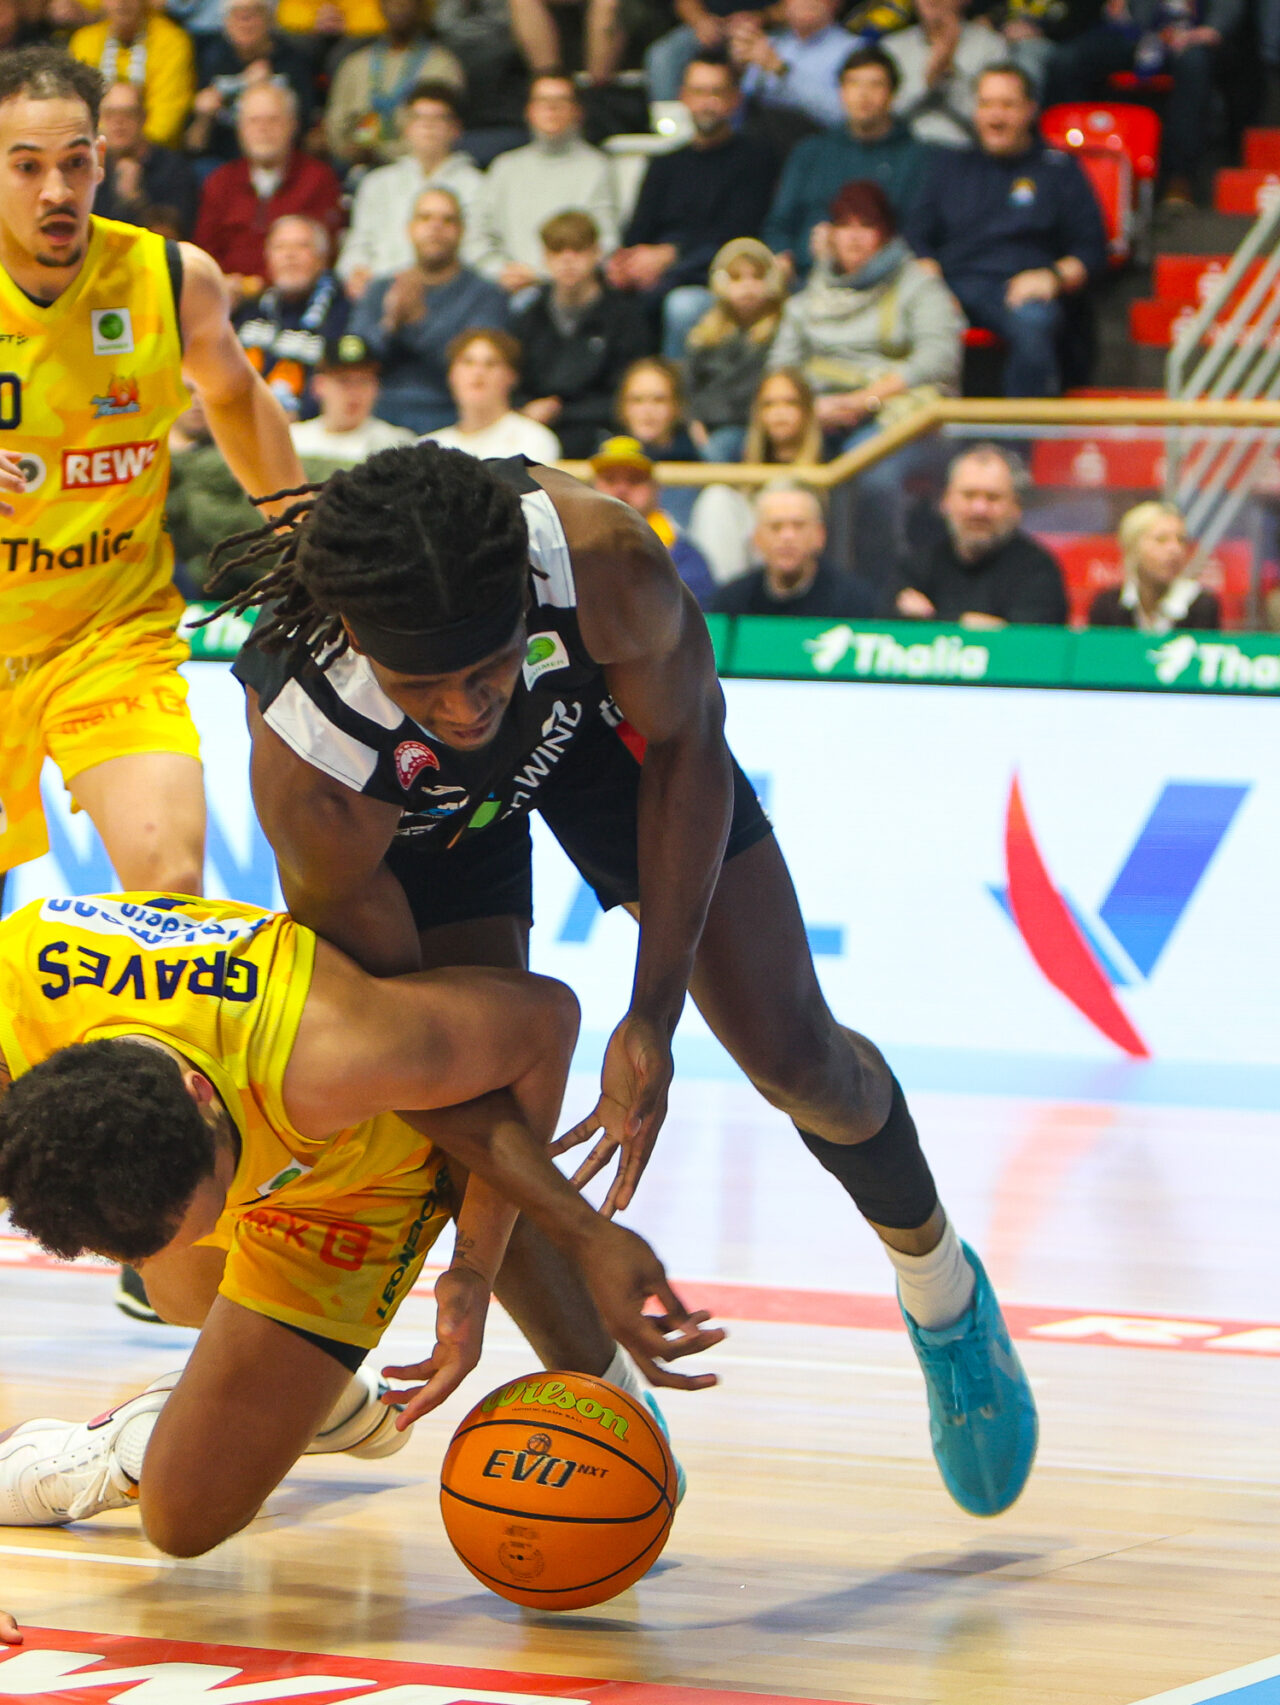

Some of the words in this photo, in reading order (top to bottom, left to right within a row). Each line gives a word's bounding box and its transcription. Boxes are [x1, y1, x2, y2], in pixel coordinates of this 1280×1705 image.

[852, 632, 988, 678] Thalia
[38, 941, 258, 1003] GRAVES
[480, 1381, 629, 1440] Wilson
[482, 1449, 577, 1489] EVO
[576, 1463, 610, 1479] NXT
